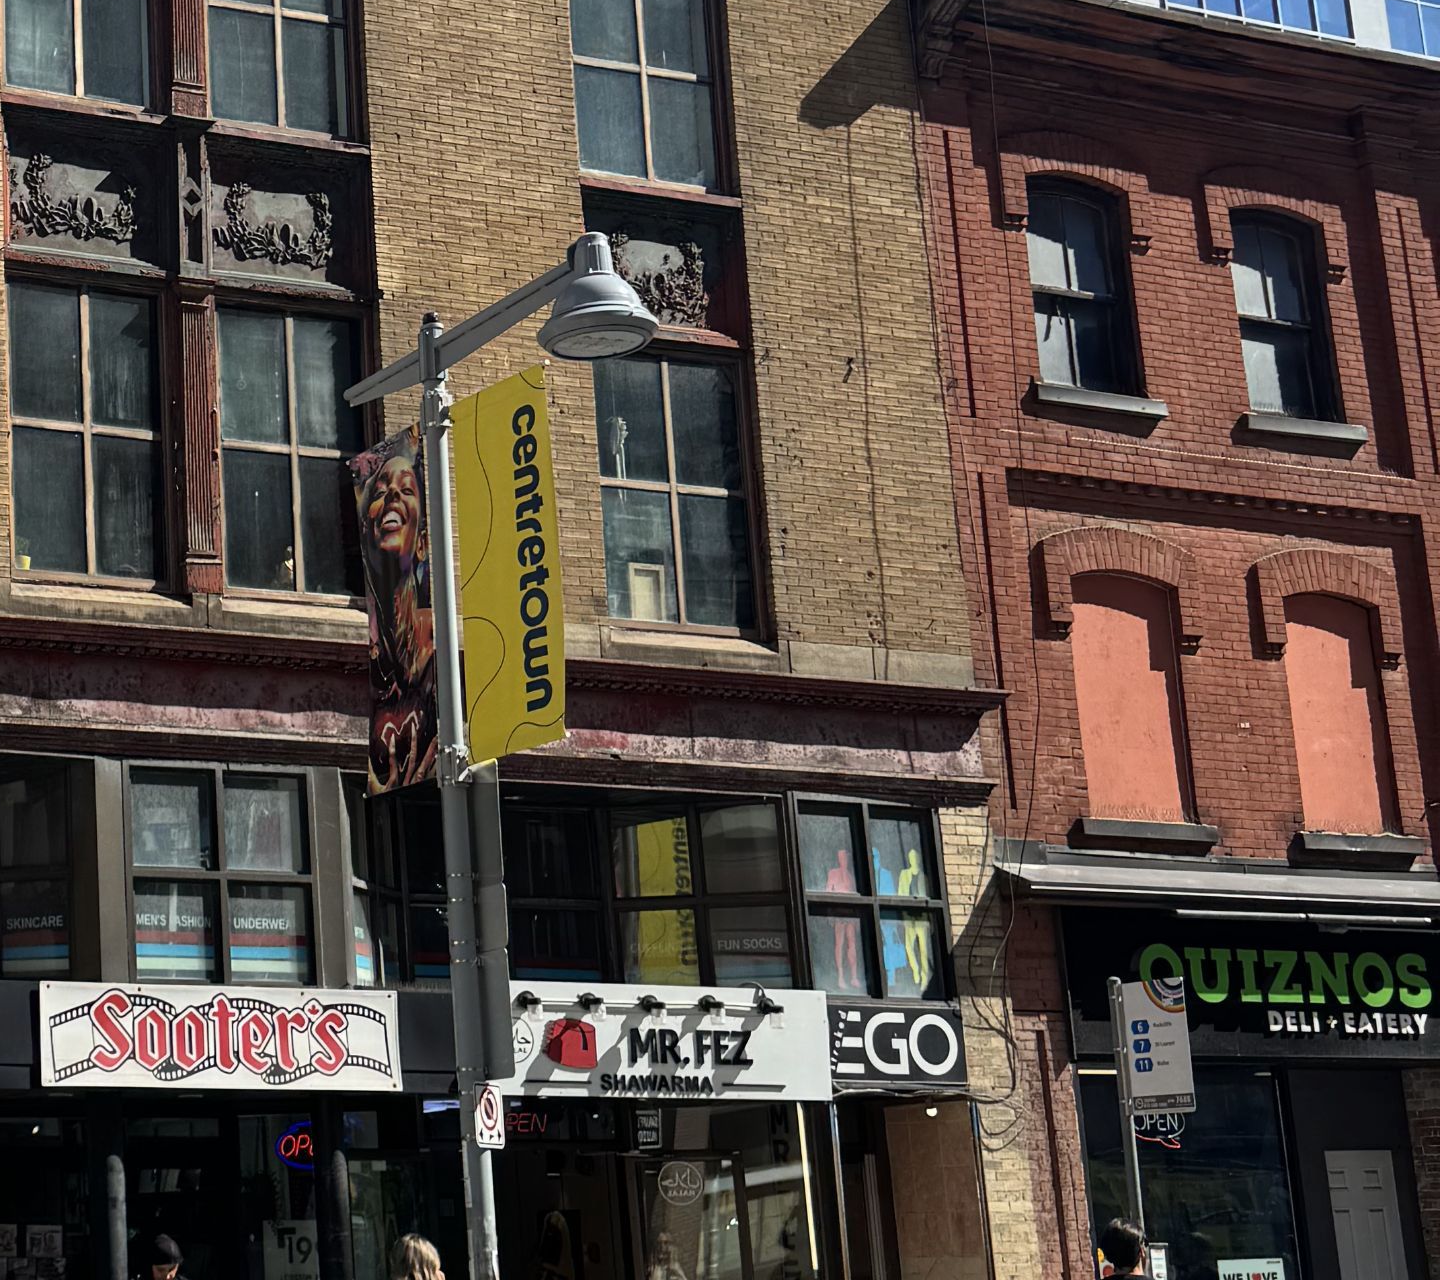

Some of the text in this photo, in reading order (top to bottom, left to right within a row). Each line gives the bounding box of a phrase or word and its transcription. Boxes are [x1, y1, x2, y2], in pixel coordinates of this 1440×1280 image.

[511, 403, 553, 713] centretown
[6, 915, 64, 930] SKINCARE
[135, 913, 212, 928] MEN'S ASHION
[233, 917, 290, 930] UNDERWE
[717, 937, 783, 951] FUN SOCKS
[1139, 943, 1432, 1009] QUIZNOS
[88, 988, 349, 1076] Sooter's
[1267, 1010, 1321, 1033] DELI
[1343, 1012, 1428, 1035] EATERY
[629, 1028, 754, 1066] MR. FEZ
[836, 1011, 958, 1076] EGO
[1139, 1060, 1149, 1071] 11
[600, 1073, 714, 1094] SHAWARMA
[506, 1112, 548, 1134] PEN
[280, 1134, 313, 1157] OP
[288, 1236, 312, 1264] 19
